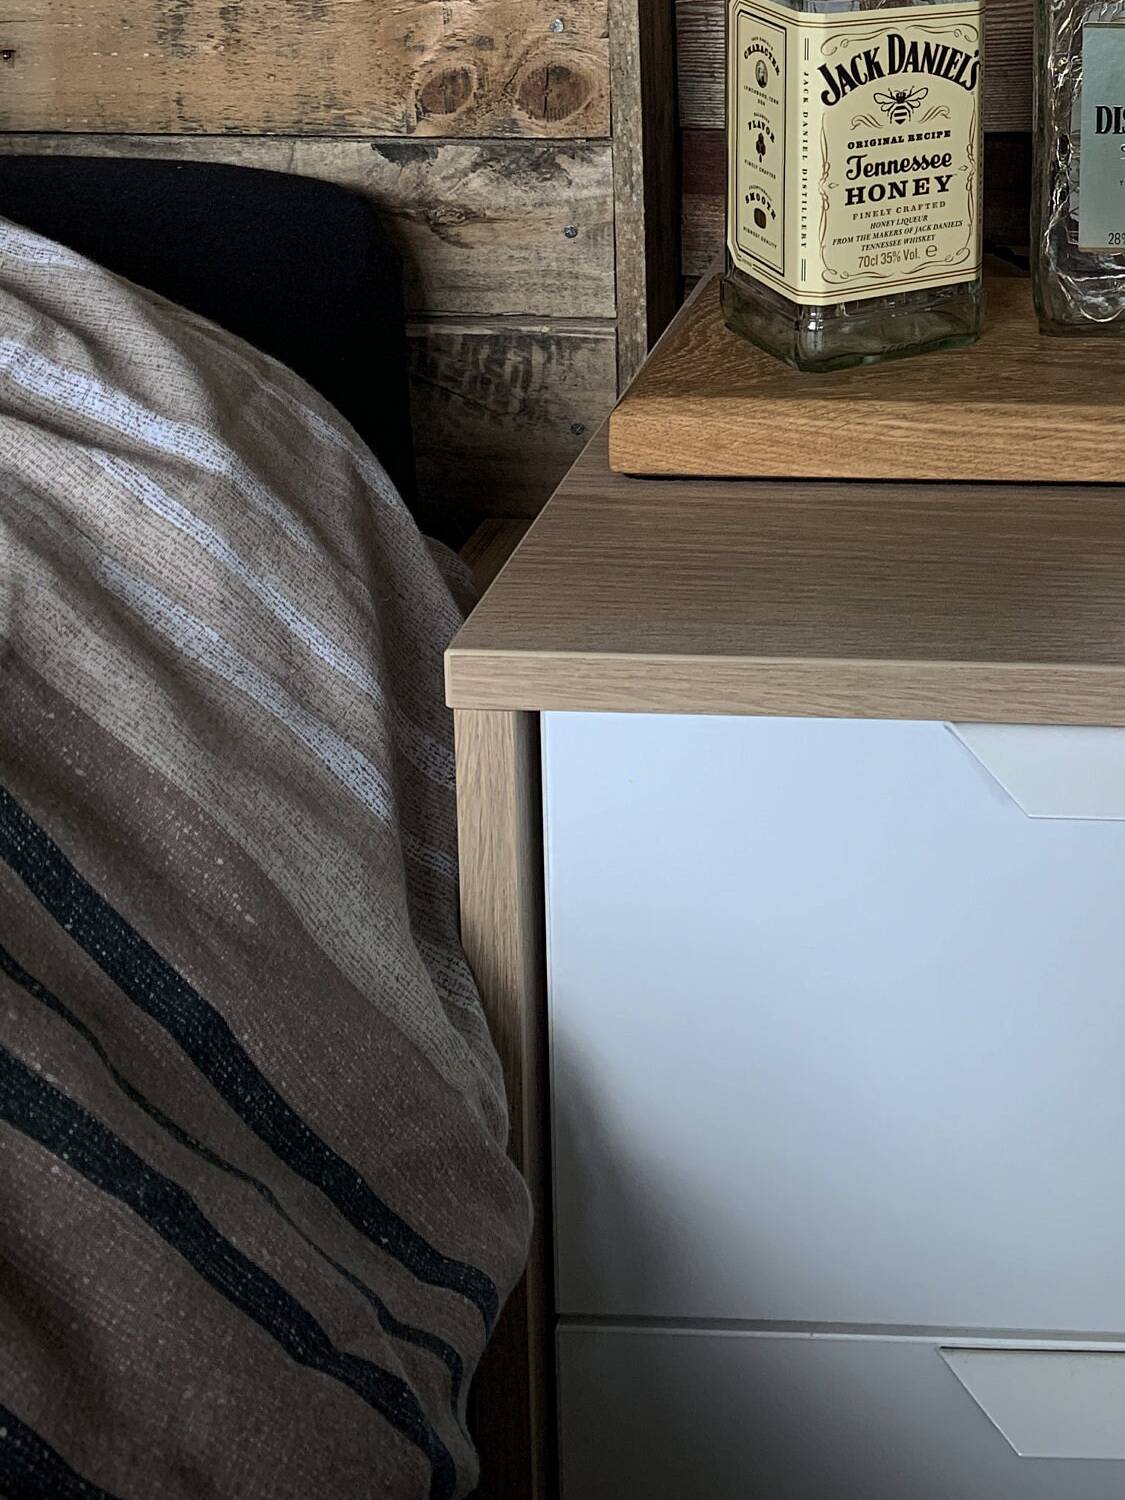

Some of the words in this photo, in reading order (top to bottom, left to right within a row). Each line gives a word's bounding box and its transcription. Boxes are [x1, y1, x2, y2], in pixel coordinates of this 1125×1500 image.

[817, 46, 886, 106] JACK
[886, 33, 981, 91] DANIEL'S
[748, 120, 775, 144] FLAVOR
[847, 135, 904, 150] ORIGINAL
[908, 130, 952, 142] RECIPE
[846, 152, 952, 180] Tennessee
[745, 192, 776, 220] SMOOTH
[852, 208, 892, 220] FINELY
[896, 201, 946, 214] CRAFTED
[870, 219, 896, 230] HONEY
[896, 214, 928, 227] LIQUEUR
[832, 236, 854, 246] FROM
[856, 234, 871, 242] THE
[872, 230, 902, 240] MAKERS
[914, 224, 932, 235] JACK
[861, 240, 901, 252] TENNESSEE
[904, 234, 936, 245] WHISKEY
[858, 253, 878, 268] 70cl
[880, 250, 901, 265] 35%
[903, 248, 920, 261] Vol.
